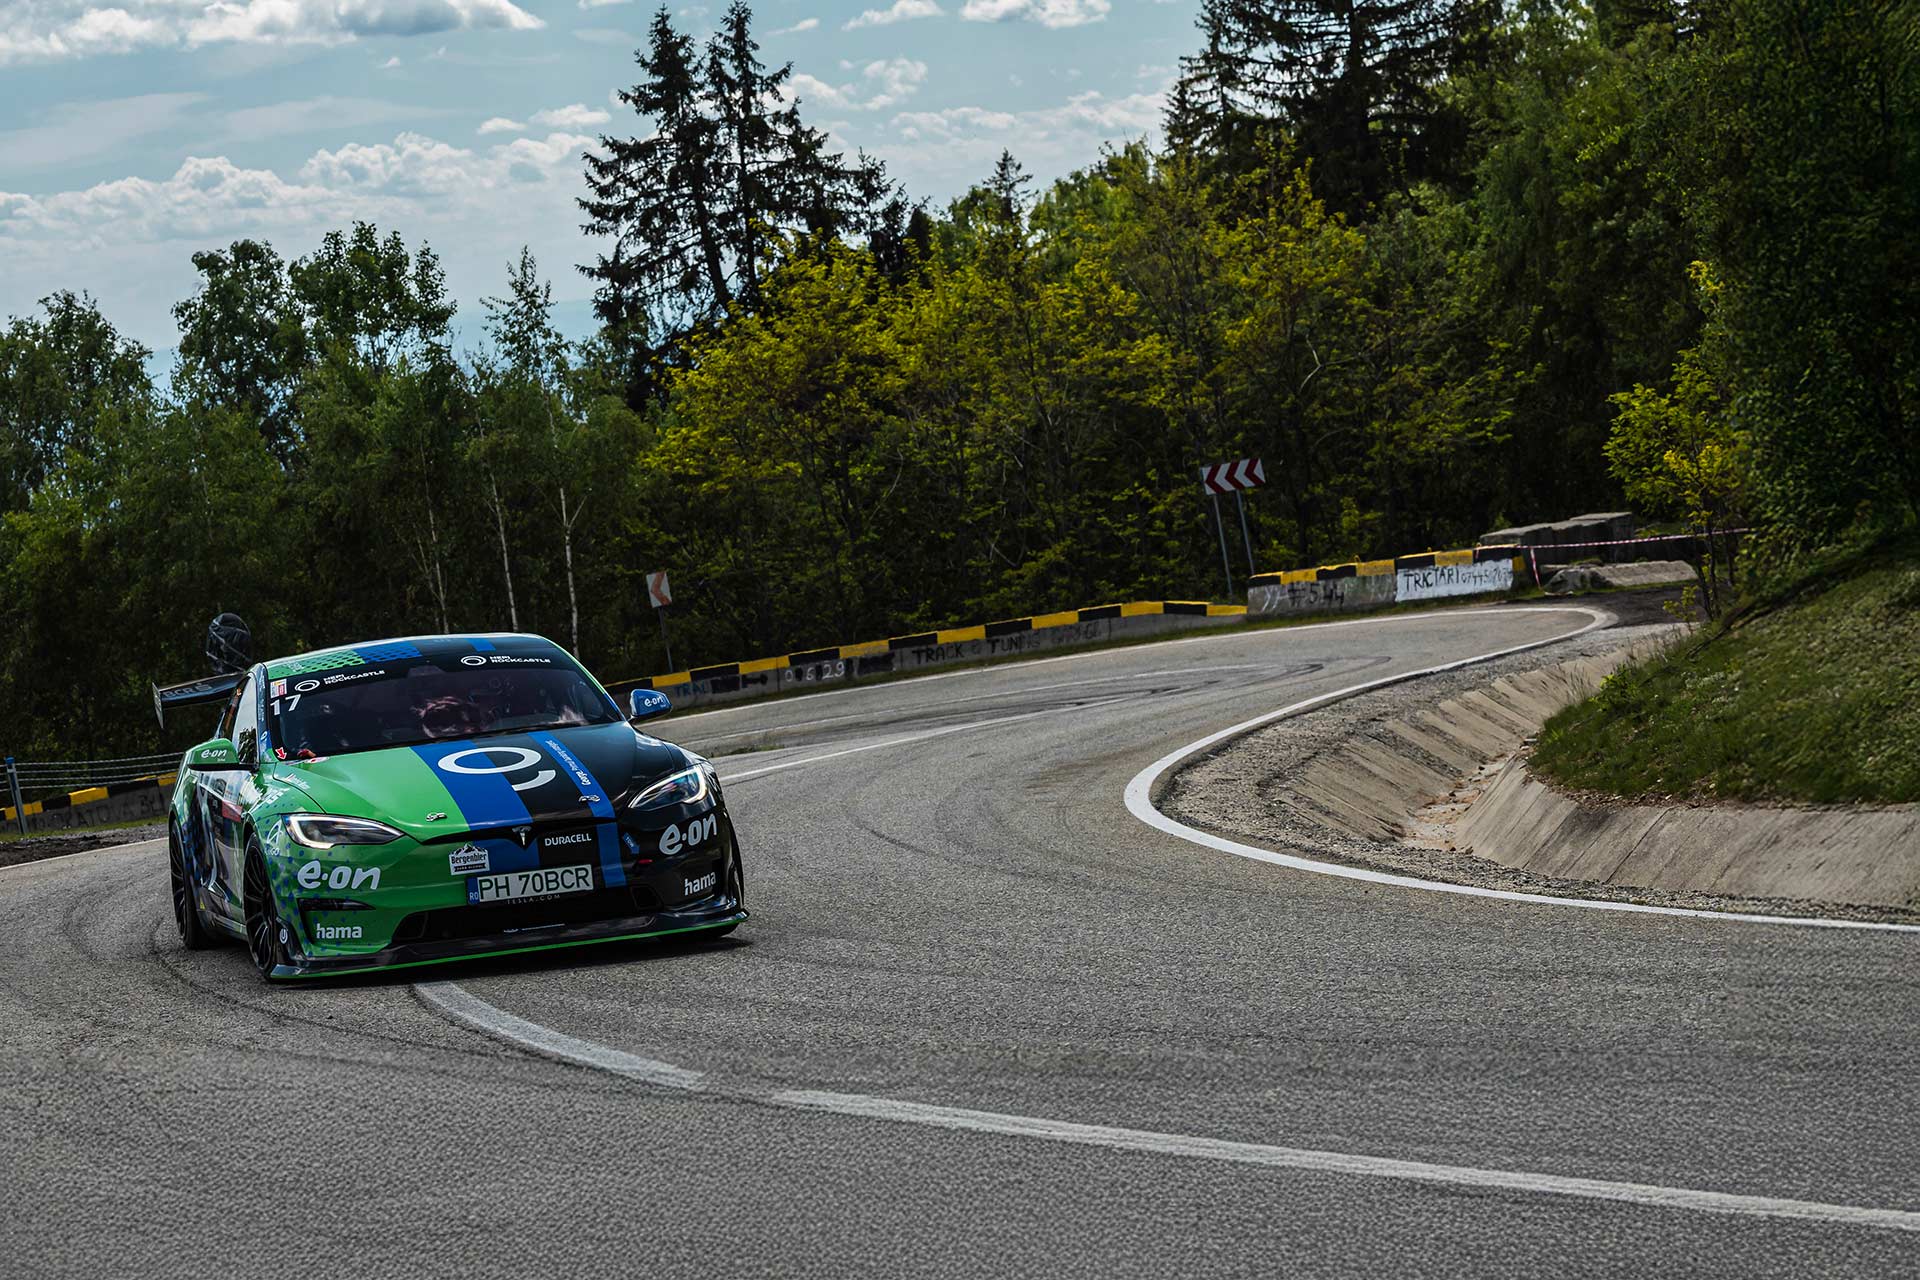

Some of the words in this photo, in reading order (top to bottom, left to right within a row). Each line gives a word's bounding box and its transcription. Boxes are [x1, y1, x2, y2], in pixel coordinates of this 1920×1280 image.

[912, 643, 965, 664] TRACK
[324, 670, 385, 685] ROCKCASTLE
[270, 694, 301, 715] 17
[544, 833, 592, 847] DURACELL
[480, 876, 511, 900] PH
[518, 867, 591, 895] 70BCR
[684, 871, 717, 896] hama
[316, 923, 363, 939] hama
